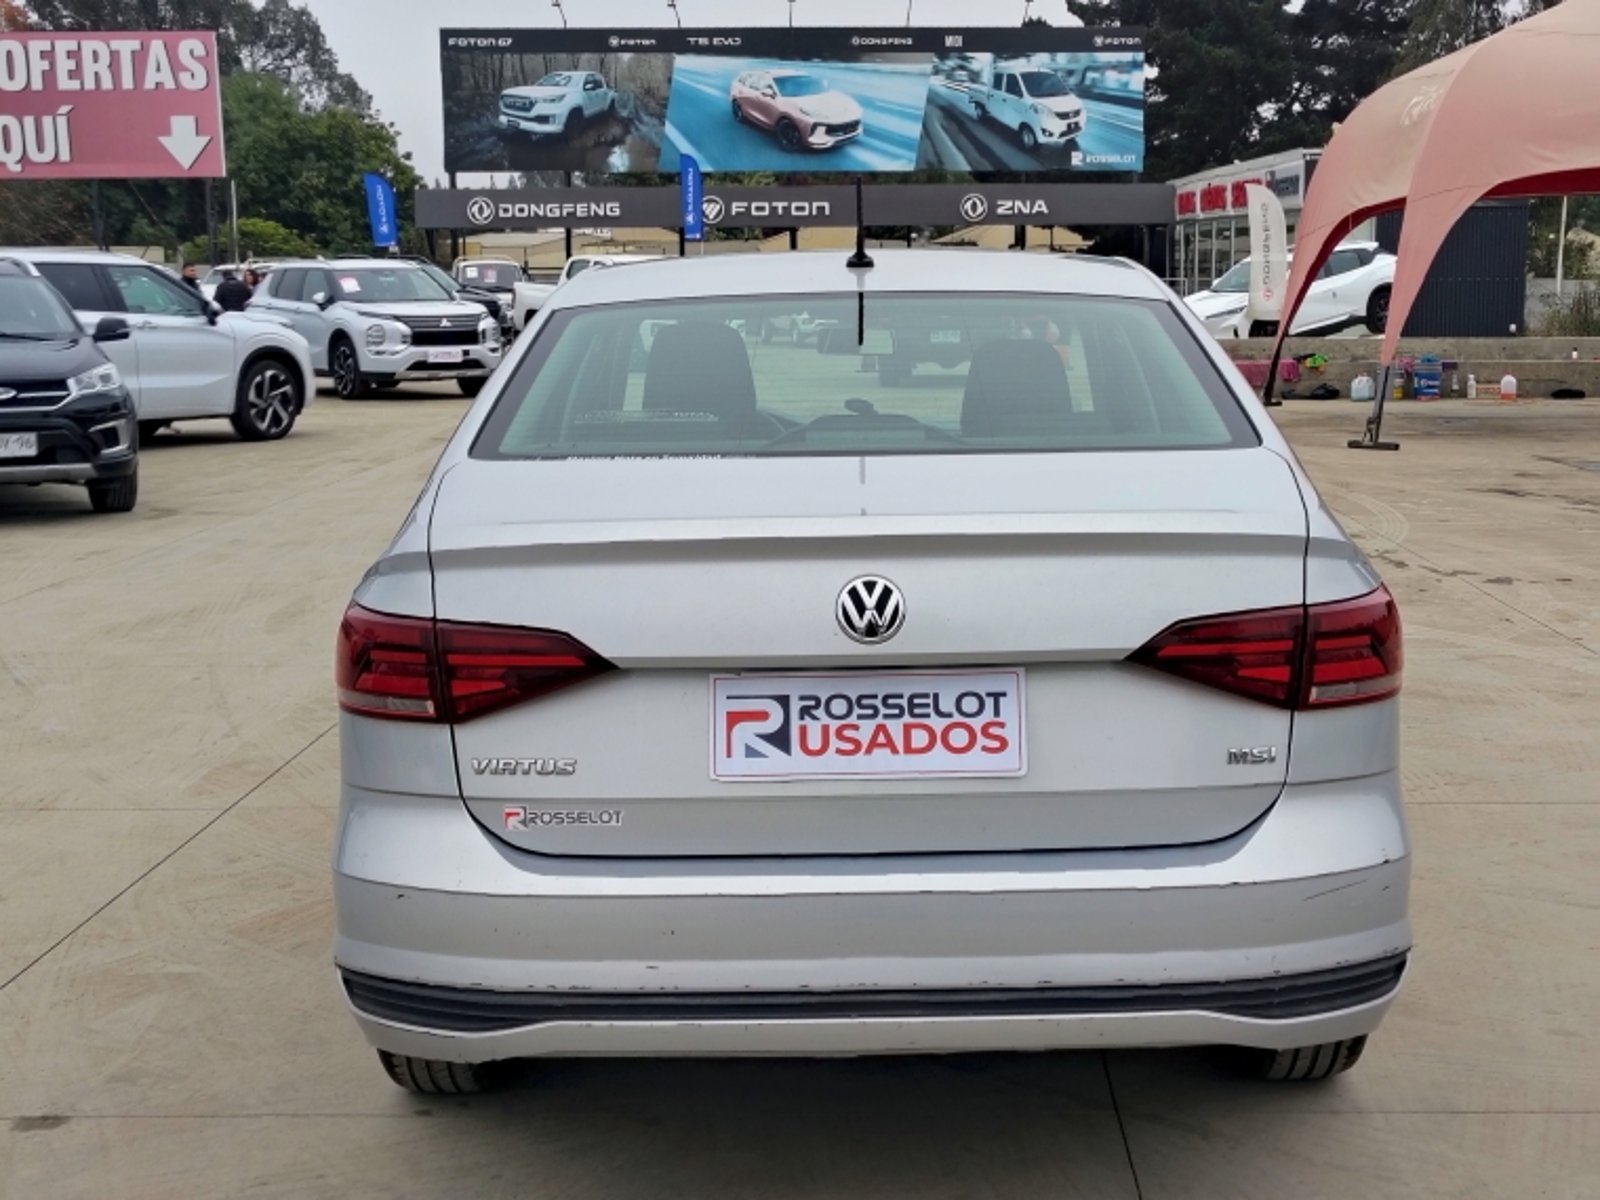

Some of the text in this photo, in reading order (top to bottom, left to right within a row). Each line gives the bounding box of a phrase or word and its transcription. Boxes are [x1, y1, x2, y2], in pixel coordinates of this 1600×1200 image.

[0, 38, 209, 92] OFERTAS
[498, 202, 622, 218] DONGFENG
[731, 201, 831, 216] FOTON
[996, 200, 1049, 215] ZNA
[798, 691, 1008, 721] ROSSELOT
[799, 721, 1009, 757] USADOS
[1226, 746, 1277, 765] MSI
[471, 757, 577, 776] VIRTUS
[527, 810, 622, 826] ROSSELOT
